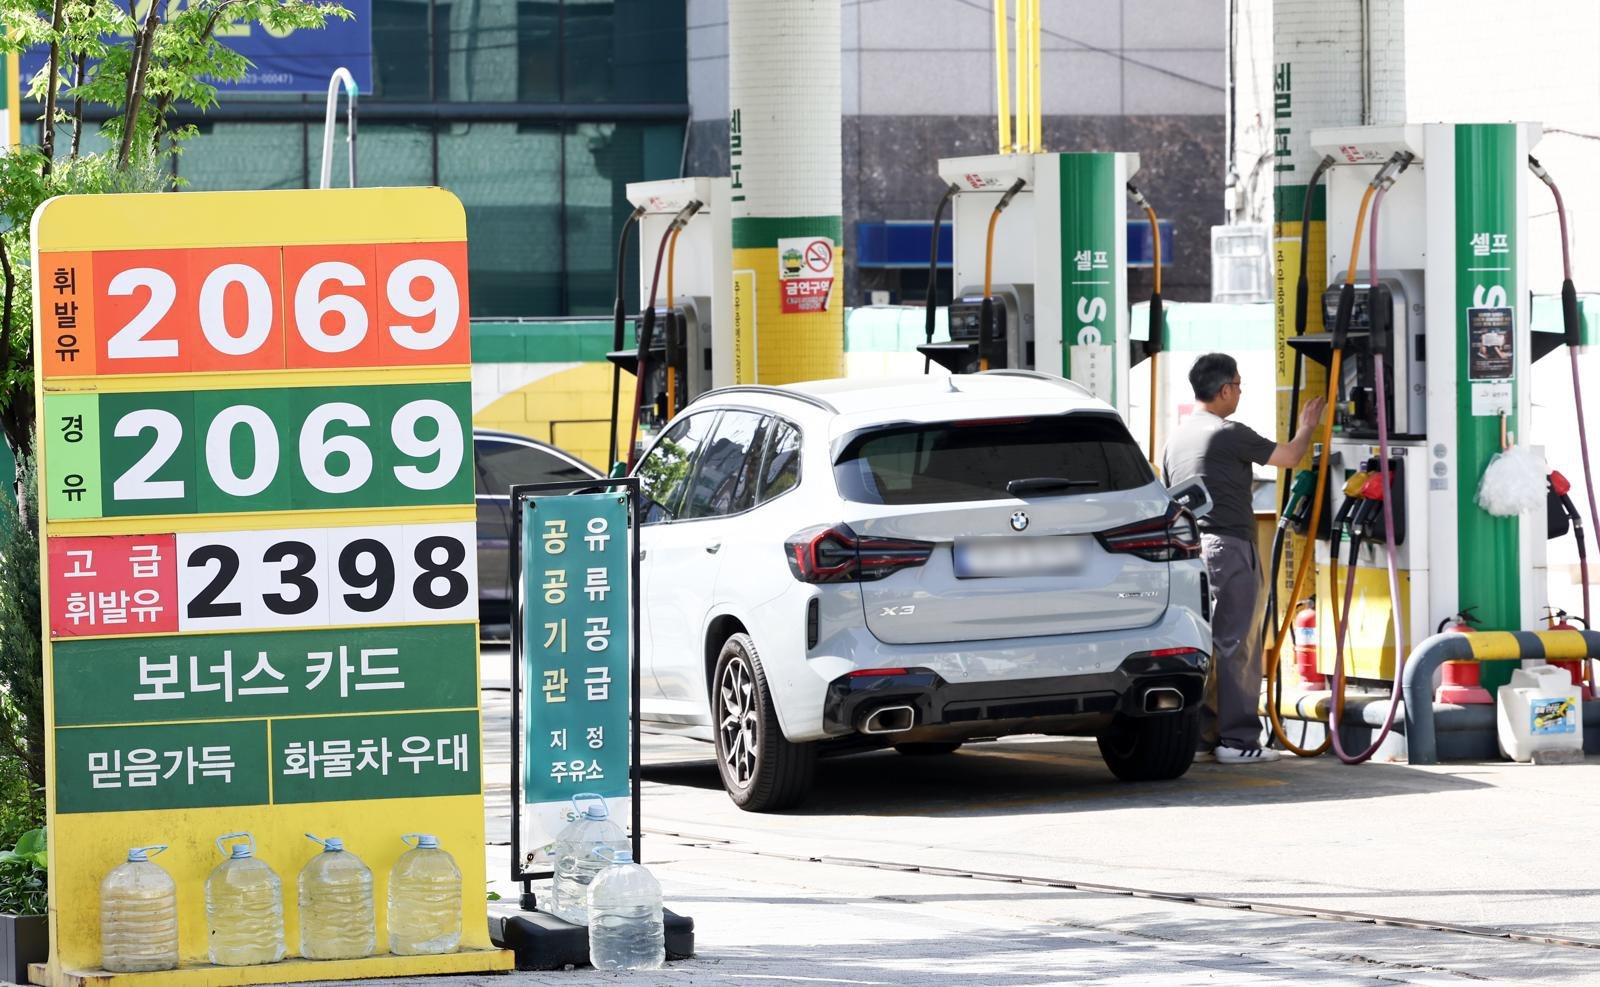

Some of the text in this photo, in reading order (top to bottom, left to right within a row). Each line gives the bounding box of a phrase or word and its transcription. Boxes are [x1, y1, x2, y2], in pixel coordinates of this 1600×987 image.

[1074, 250, 1109, 271] 셀프
[1470, 232, 1509, 256] 셀프
[54, 267, 80, 362] 휘발유
[107, 259, 460, 359] 2069
[1077, 296, 1107, 345] Se
[61, 414, 87, 502] 경유
[113, 399, 464, 500] 2069
[187, 536, 469, 618] 2398
[65, 589, 163, 625] 휘발유
[542, 519, 568, 703] 공공기관
[584, 517, 611, 701] 유류공급
[880, 605, 915, 616] X3
[133, 645, 405, 703] 보너스 카드
[88, 746, 235, 789] 믿음가득
[550, 759, 604, 784] 주유소
